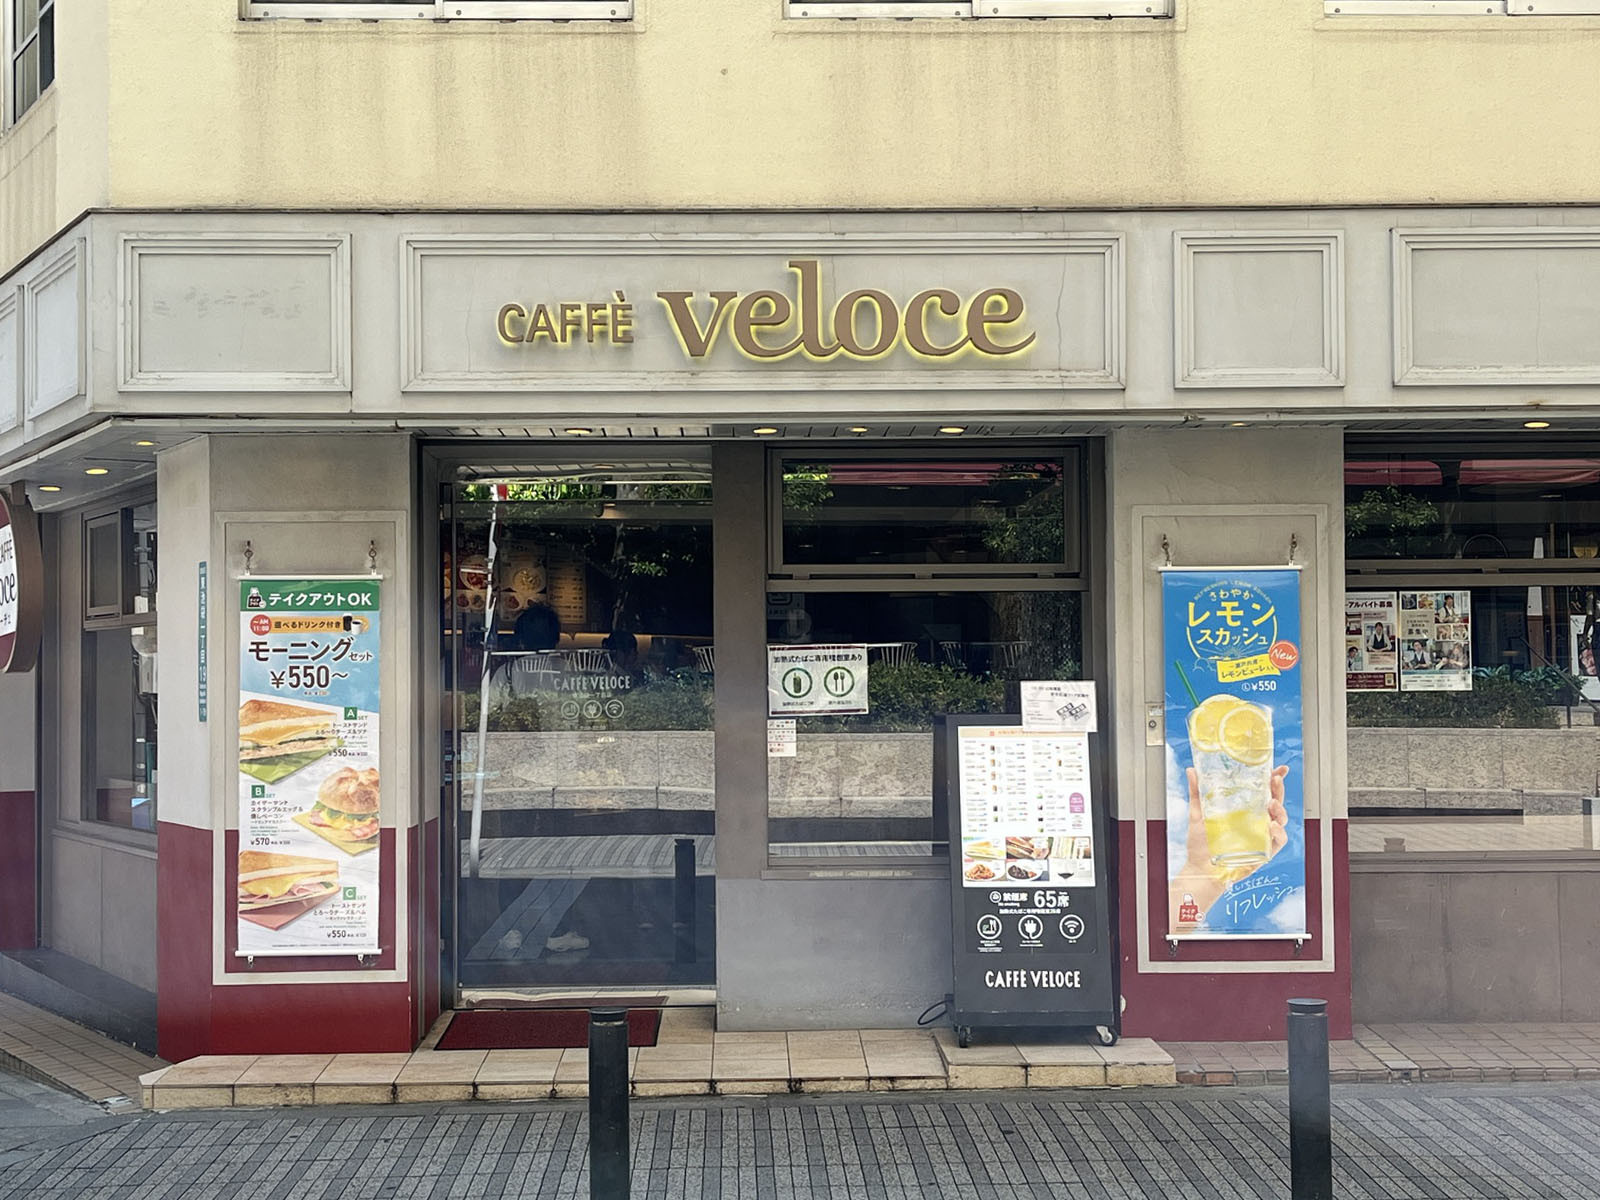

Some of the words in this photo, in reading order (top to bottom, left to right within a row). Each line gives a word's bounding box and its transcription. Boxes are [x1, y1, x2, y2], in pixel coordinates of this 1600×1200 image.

[498, 290, 635, 344] CAFFÈ
[656, 260, 1037, 362] veloce
[268, 593, 372, 606] テイクアウトOK
[1208, 588, 1254, 601] さわやか
[1188, 602, 1276, 627] レモン
[1196, 628, 1268, 646] スカッシュ
[1271, 648, 1297, 660] New
[590, 676, 630, 690] VELOCE
[1252, 680, 1276, 691] ¥550
[1034, 890, 1070, 908] 65席
[985, 969, 1027, 988] CAFFÈ
[1030, 970, 1081, 988] VELOCE
